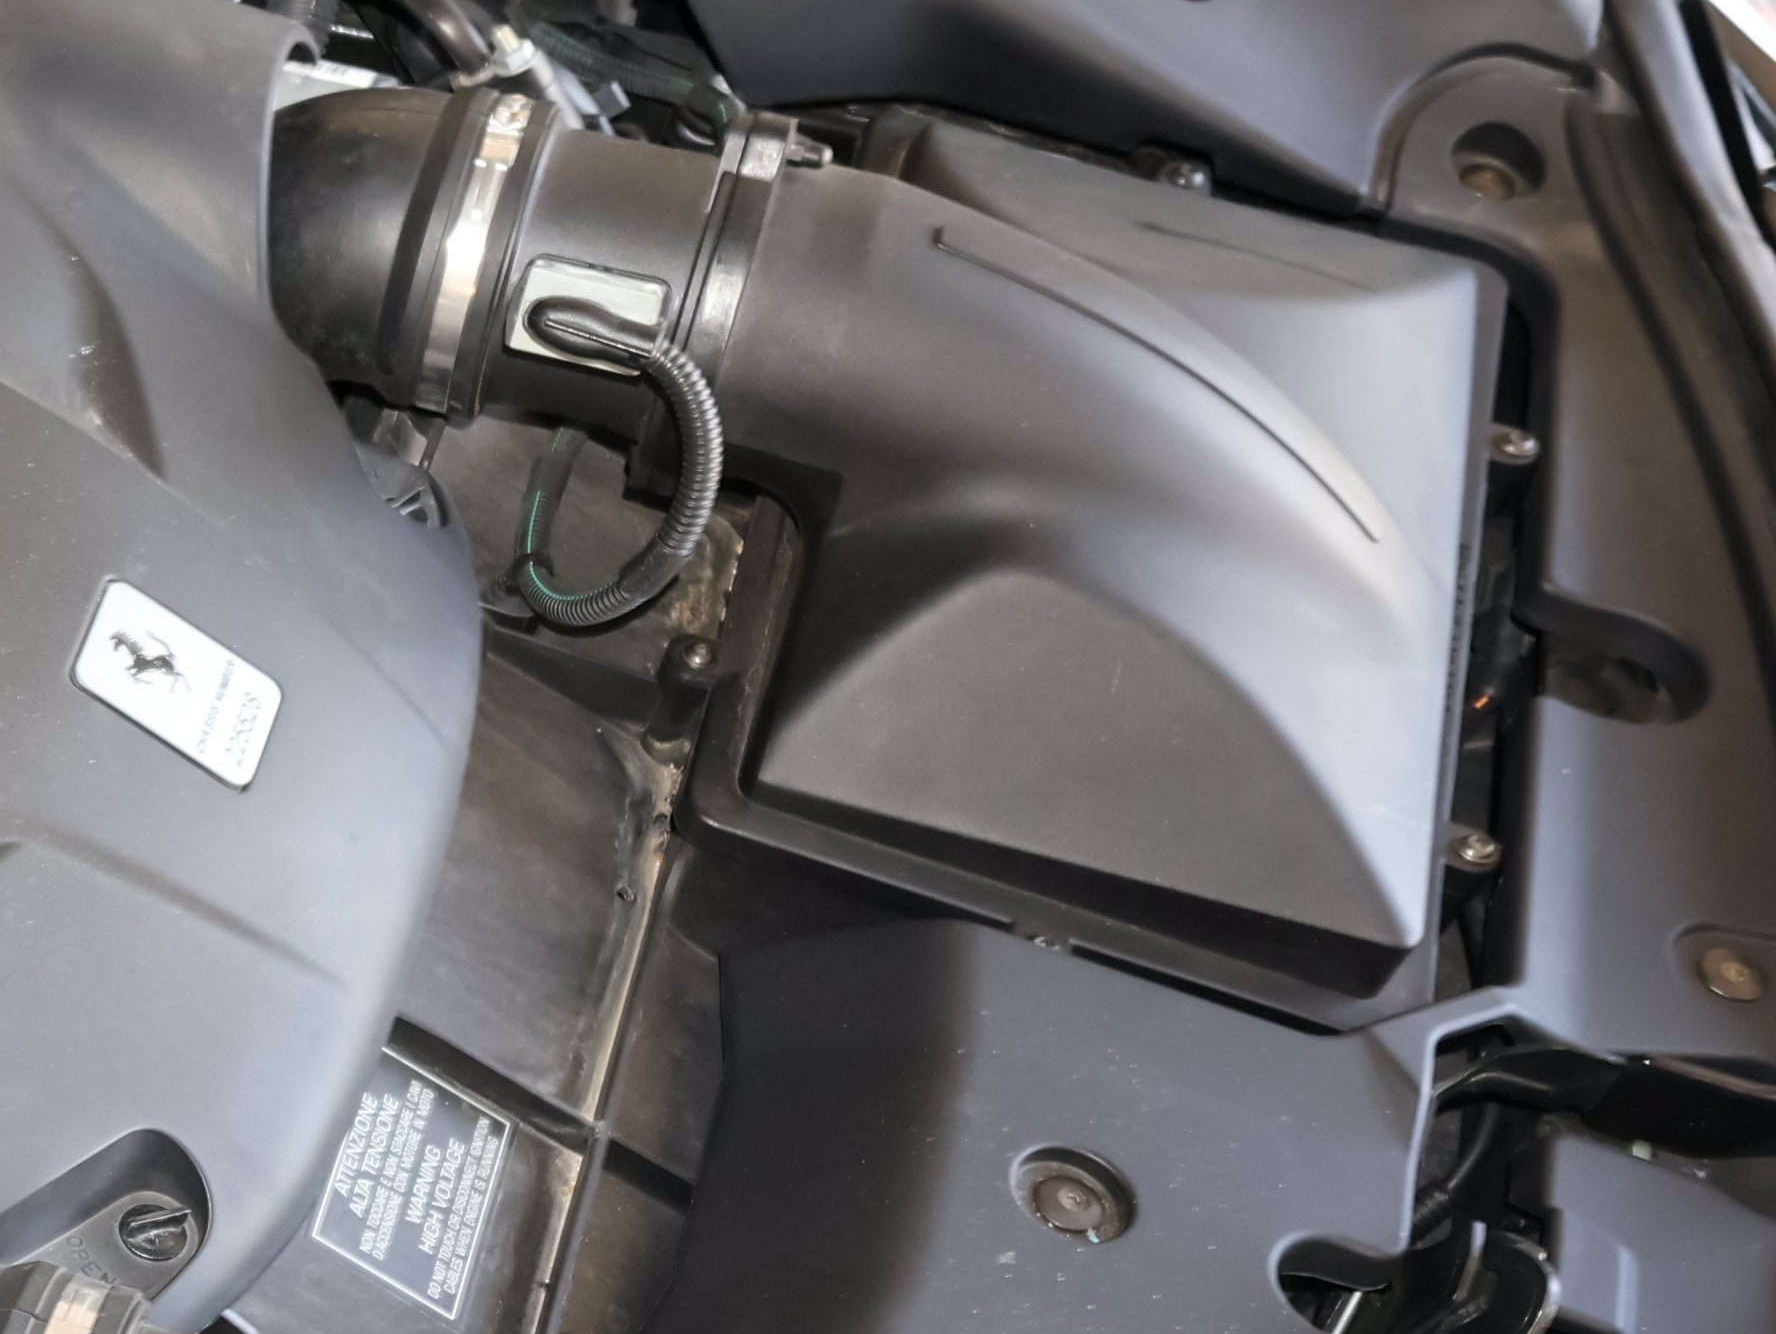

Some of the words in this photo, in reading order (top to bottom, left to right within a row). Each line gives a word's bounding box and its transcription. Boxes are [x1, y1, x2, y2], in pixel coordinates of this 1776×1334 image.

[416, 1088, 433, 1118] MOTO
[390, 1107, 413, 1155] STACCARE
[412, 1116, 424, 1130] IN
[469, 1115, 490, 1158] IGNITION
[333, 1090, 378, 1198] ATTENZIONE
[348, 1175, 373, 1218] ALTA
[361, 1092, 399, 1177] TENSIONE
[400, 1129, 421, 1170] MOTORE
[477, 1135, 499, 1180] RUNNING
[383, 1154, 398, 1178] NON
[393, 1169, 408, 1193] CON
[404, 1142, 441, 1226] WARNING
[418, 1209, 443, 1255] HIGH
[431, 1137, 465, 1211] VOLTAGE
[452, 1155, 478, 1216] DISCONNECT
[473, 1178, 486, 1192] IS
[367, 1185, 389, 1230] TOCCARE
[447, 1212, 461, 1231] OR
[463, 1190, 482, 1227] ENGINE
[359, 1229, 376, 1255] NON
[438, 1227, 457, 1263] TOUCH
[454, 1225, 472, 1258] WHEN
[427, 1280, 441, 1300] DO
[432, 1260, 447, 1284] NOT
[443, 1255, 463, 1294] CABLES
